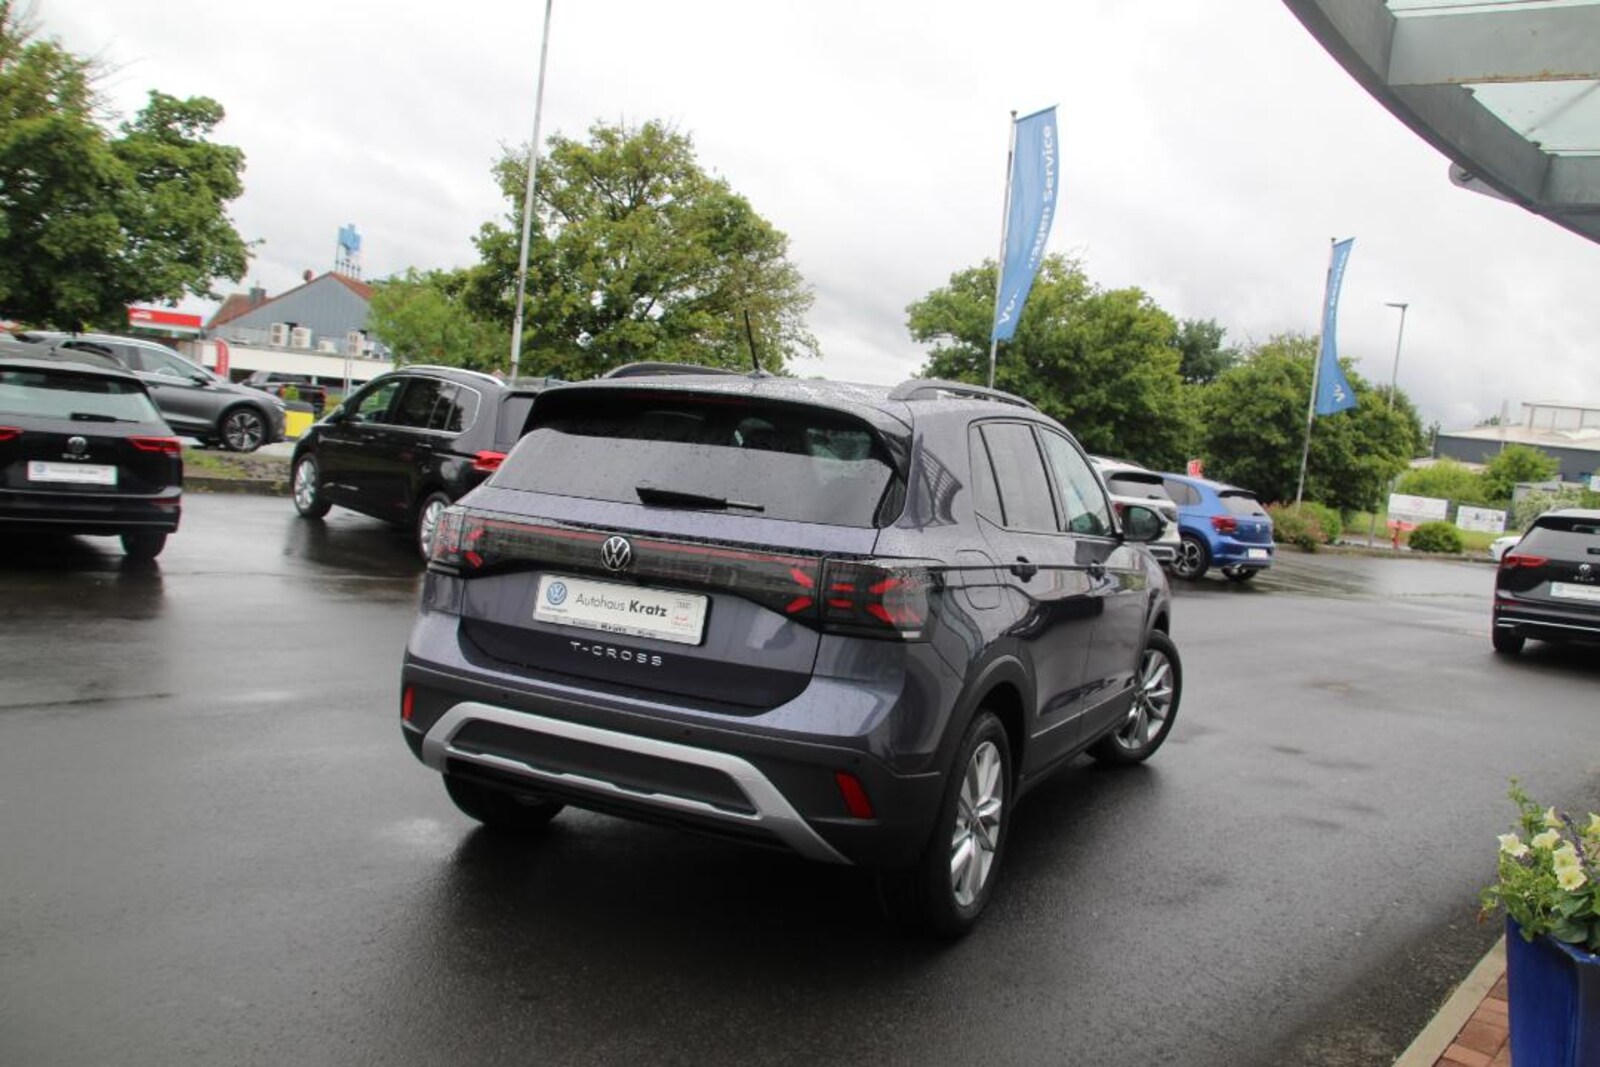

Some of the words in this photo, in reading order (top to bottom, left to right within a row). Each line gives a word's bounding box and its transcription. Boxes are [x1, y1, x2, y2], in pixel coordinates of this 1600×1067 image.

[1043, 125, 1054, 204] Service
[575, 593, 626, 612] Autohaus
[628, 600, 668, 617] Kratz
[569, 640, 663, 667] T-CROSS
